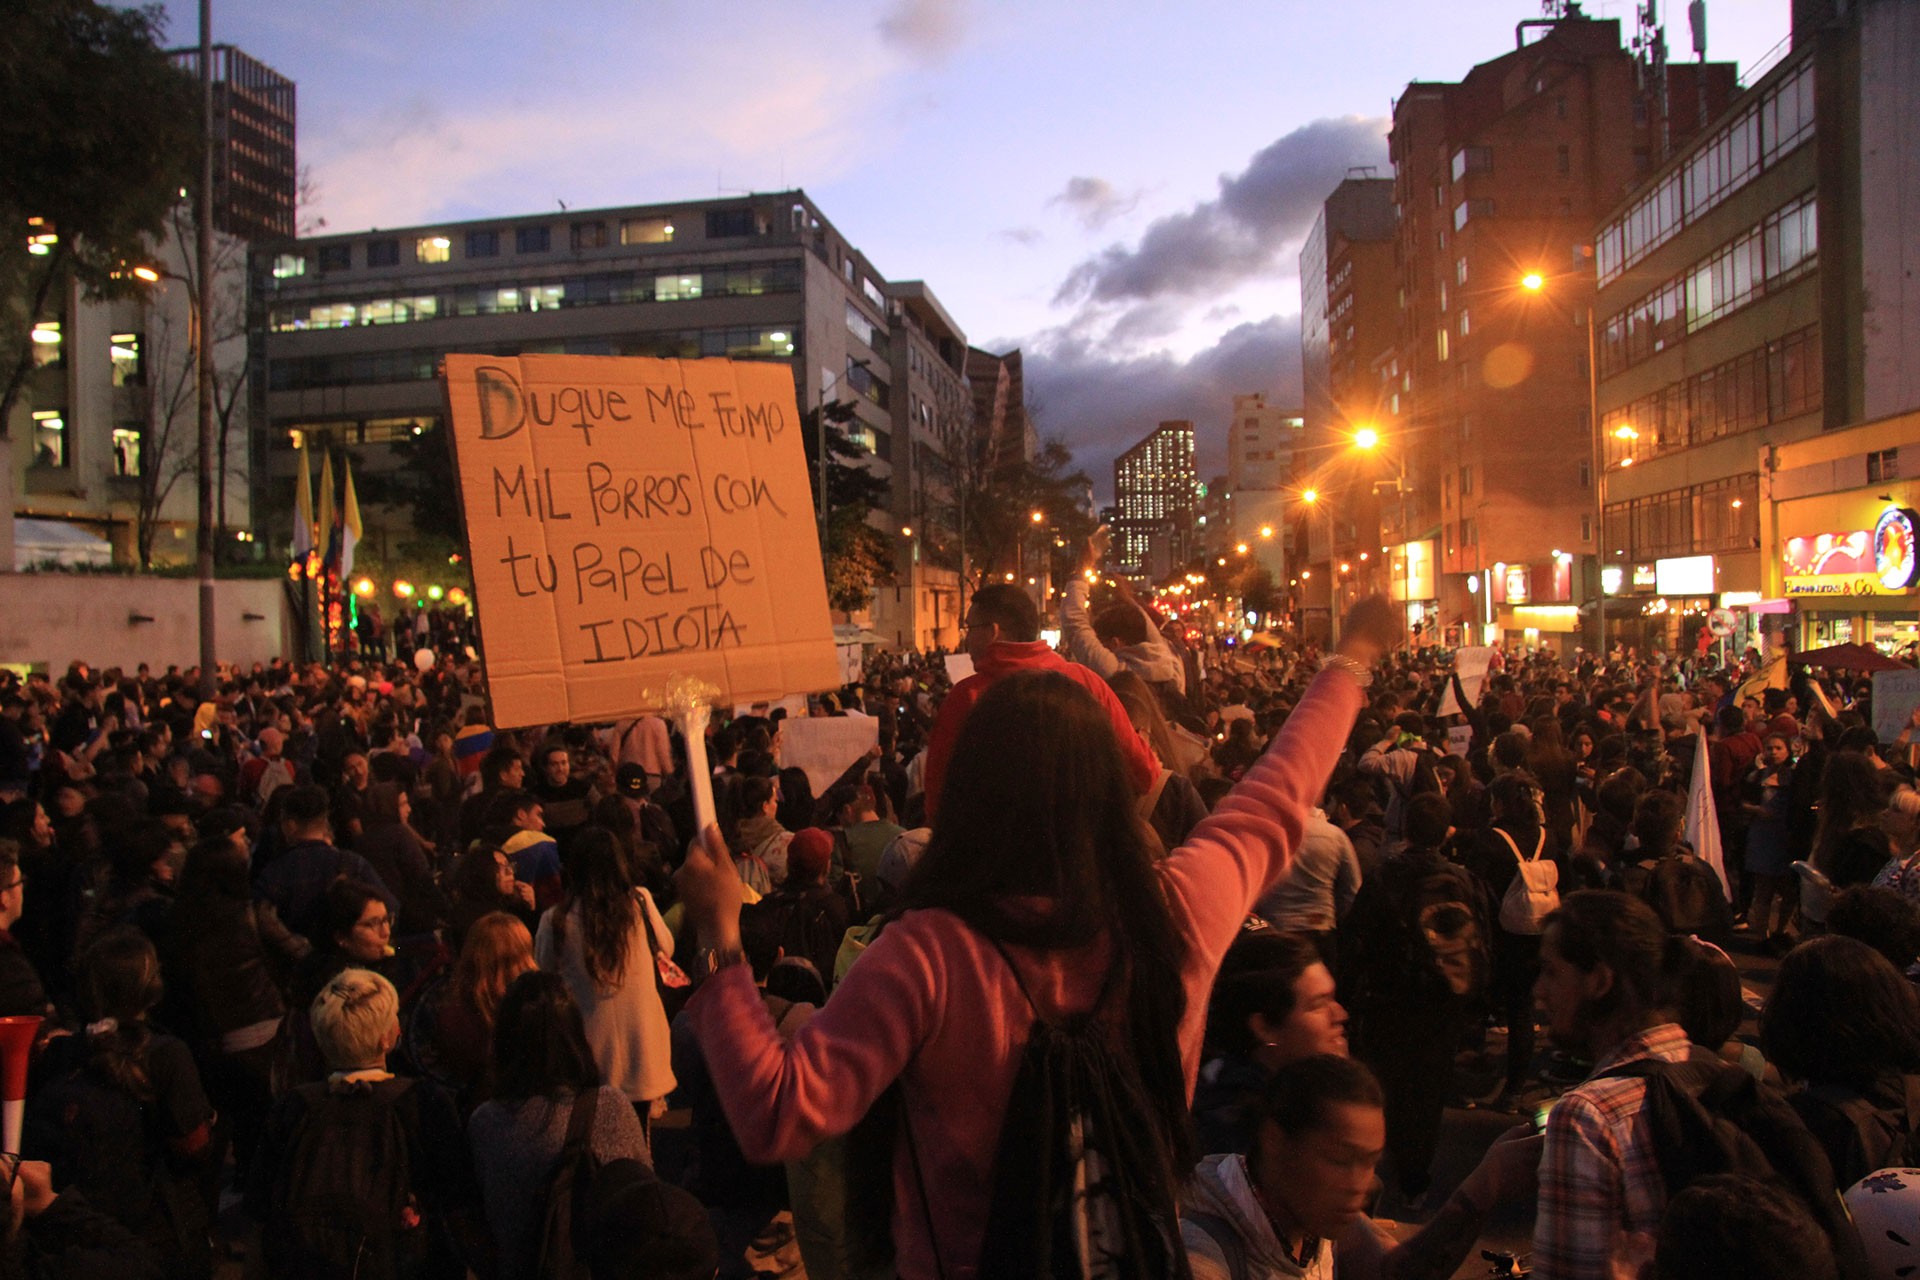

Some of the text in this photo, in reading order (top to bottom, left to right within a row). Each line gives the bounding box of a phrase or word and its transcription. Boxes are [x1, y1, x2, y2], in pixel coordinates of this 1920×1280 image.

[475, 366, 632, 446] Duque
[493, 464, 572, 523] MIL
[580, 603, 748, 664] IDIOTA
